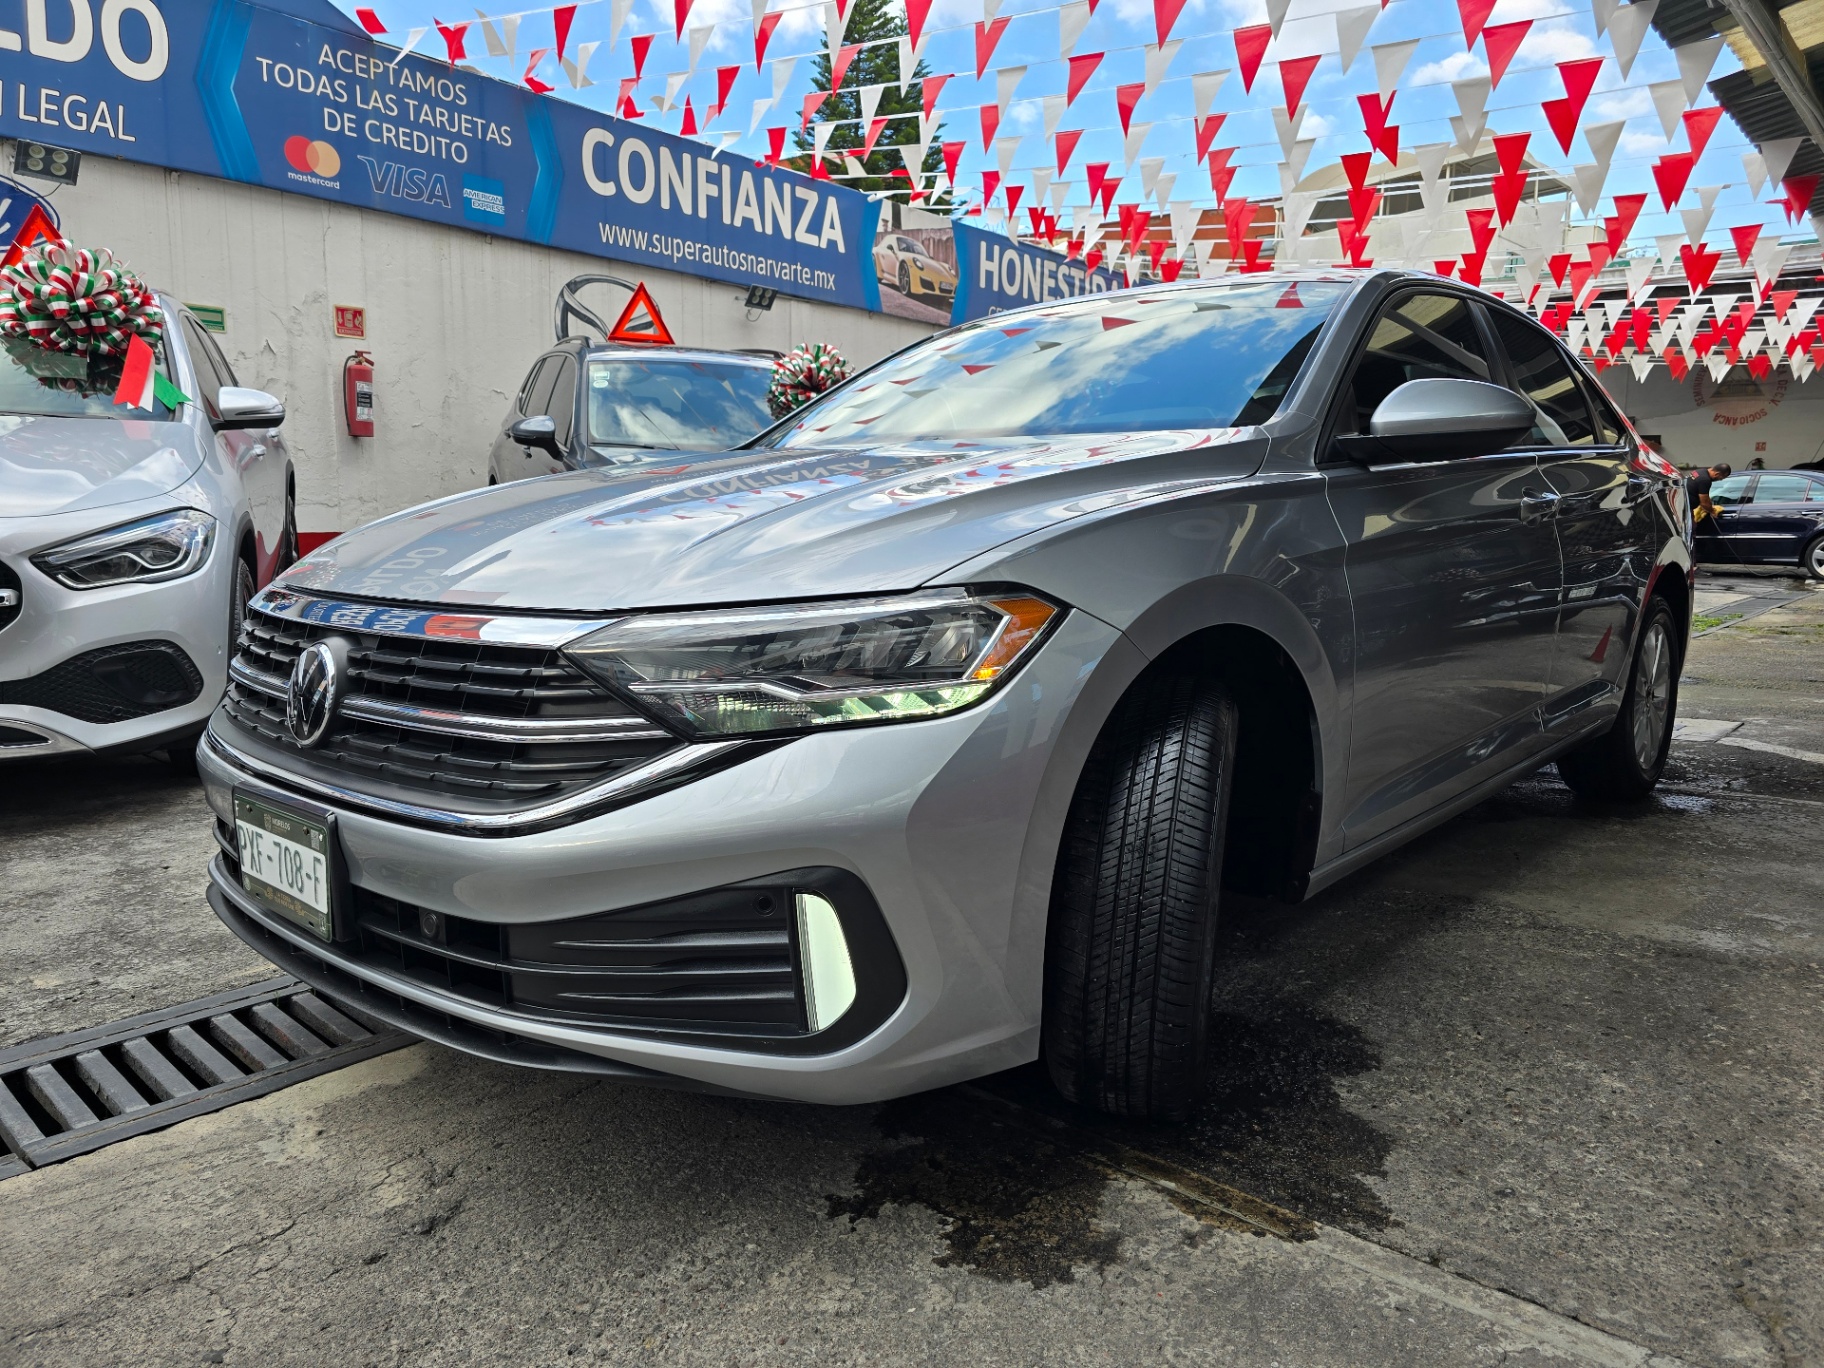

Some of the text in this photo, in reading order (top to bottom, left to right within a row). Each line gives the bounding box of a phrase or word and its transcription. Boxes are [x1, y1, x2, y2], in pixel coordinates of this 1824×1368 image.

[0, 0, 169, 82] DO
[255, 56, 513, 147] TODAS LAS TARJETAS
[318, 44, 468, 105] ACEPTAMOS
[18, 83, 136, 142] LEGAL
[323, 107, 469, 164] DE CREDITO
[287, 171, 340, 190] mastercard
[356, 154, 452, 208] VISA
[463, 188, 503, 205] AMERICAN
[472, 199, 505, 215] EXPRESS
[581, 127, 846, 254] CONFIANZA
[598, 221, 836, 291] www.superautosnarvarte.mx
[1740, 408, 1768, 425] SOCIO
[237, 824, 323, 906] PXF-708-F
